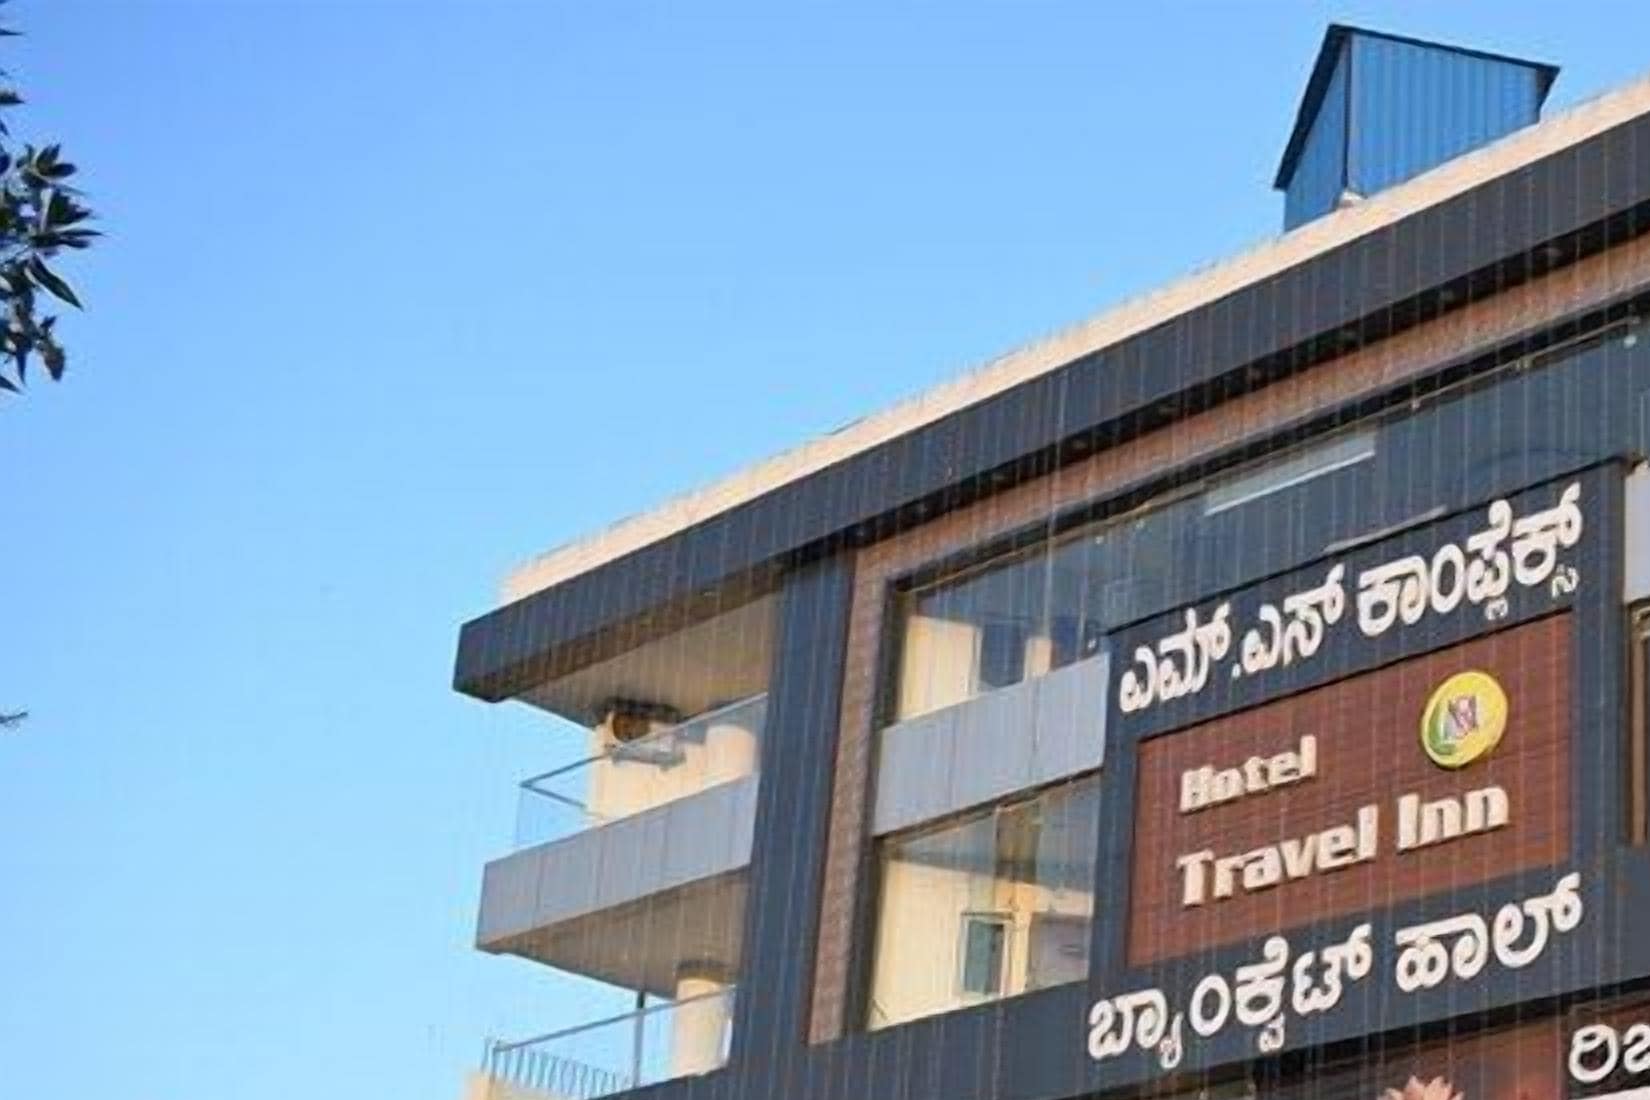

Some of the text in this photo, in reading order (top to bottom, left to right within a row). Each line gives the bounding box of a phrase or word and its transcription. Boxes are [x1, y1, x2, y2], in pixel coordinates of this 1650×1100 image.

[1178, 735, 1317, 813] Hotel
[1176, 785, 1510, 907] Travel Inn
[1396, 872, 1583, 992] ಹಾಲ್
